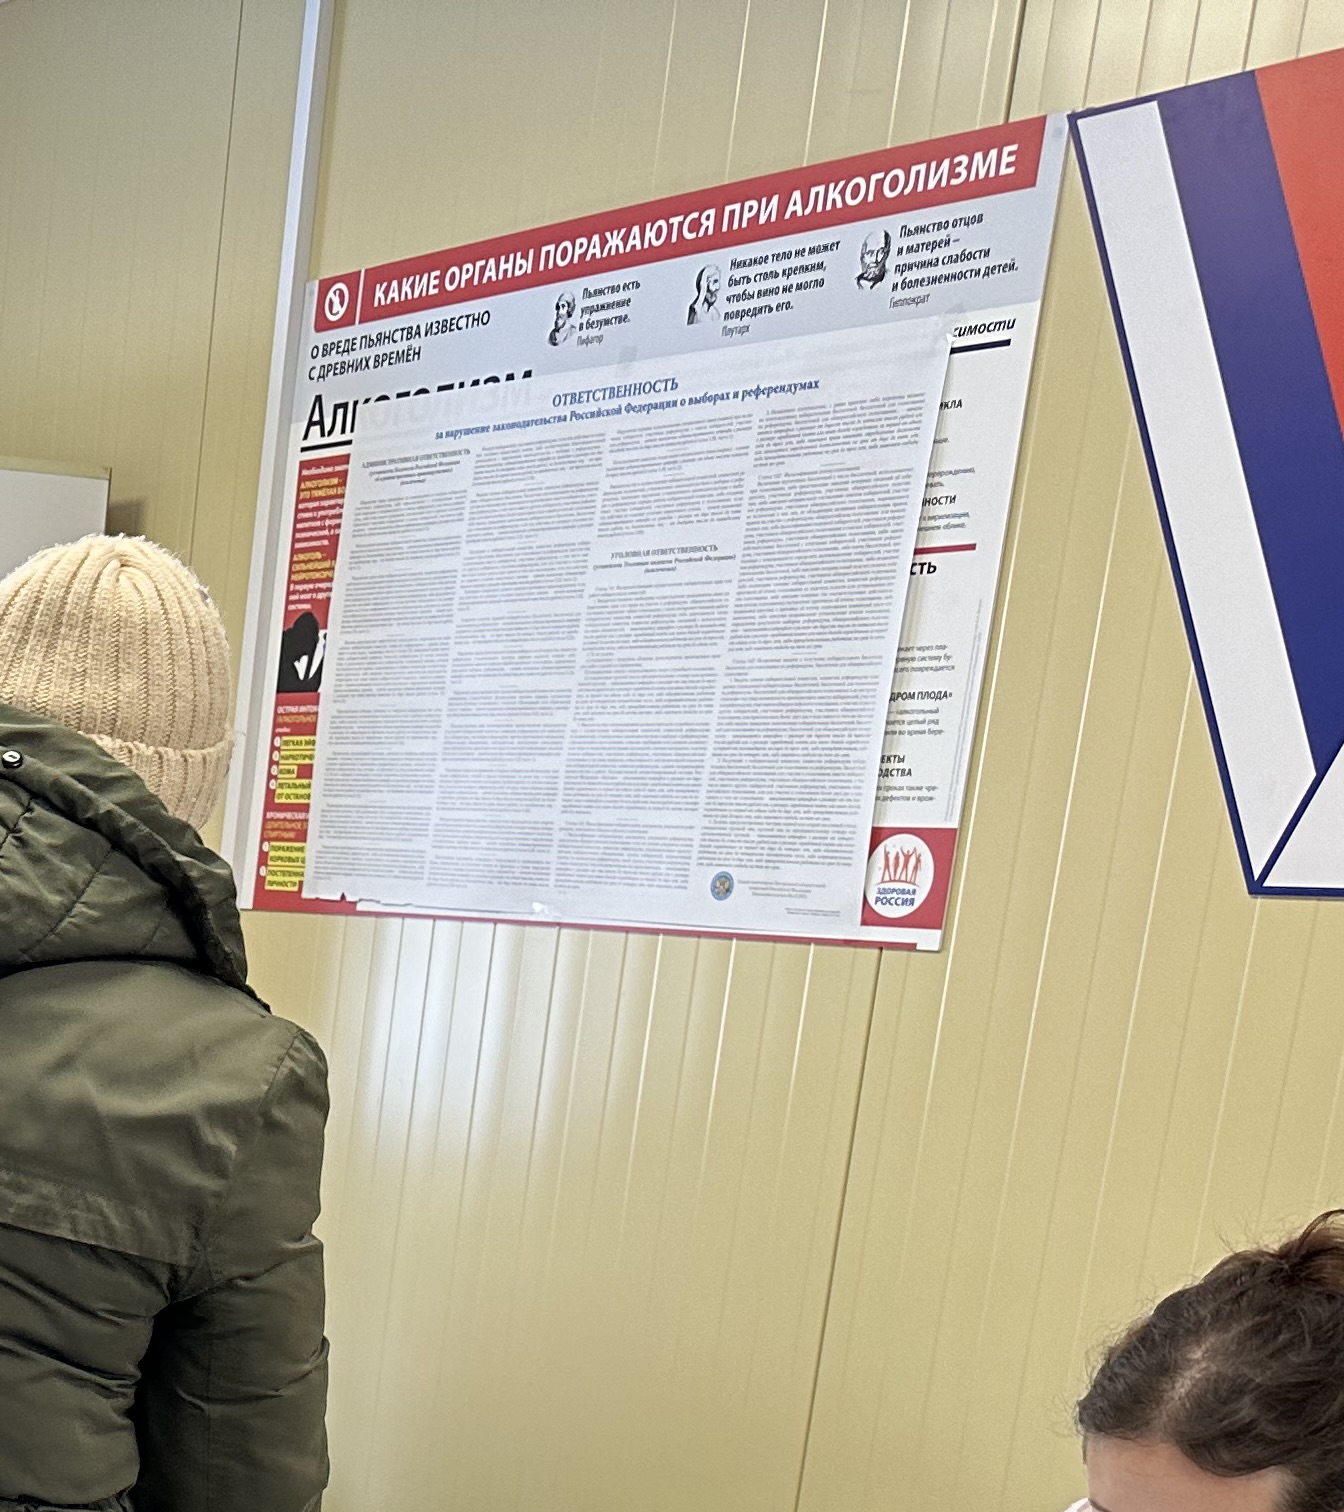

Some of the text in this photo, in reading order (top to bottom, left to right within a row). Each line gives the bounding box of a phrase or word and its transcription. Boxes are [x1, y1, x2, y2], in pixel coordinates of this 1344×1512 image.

[373, 143, 1018, 308] КАКИЕ ОРГАНЫ ПОРАЖАЮТСЯ ПРИ АЛКОГОЛИЗМЕ
[898, 212, 984, 239] Пьянство отцов
[728, 239, 841, 272] Никакое тело не может
[895, 232, 951, 257] и матерей
[726, 259, 827, 288] быть столь крепким,
[890, 257, 1019, 293] и болезненности детей.
[893, 246, 991, 277] причина слабости
[621, 279, 641, 292] есть
[724, 276, 825, 305] чтобы вино не могло
[722, 299, 794, 322] повредить его.
[309, 308, 491, 360] О ВРЕДЕ ПЬЯНСТВА ИЗВЕСТНО
[307, 342, 422, 383] С ДРЕВНИХ ВРЕМЁН
[551, 376, 679, 408] ОТВЕТСТВЕННОСТЬ
[434, 378, 820, 441] за нарушение законодательства Российской Федерации о выборах и референдумах
[873, 894, 916, 907] РОССИЯ
